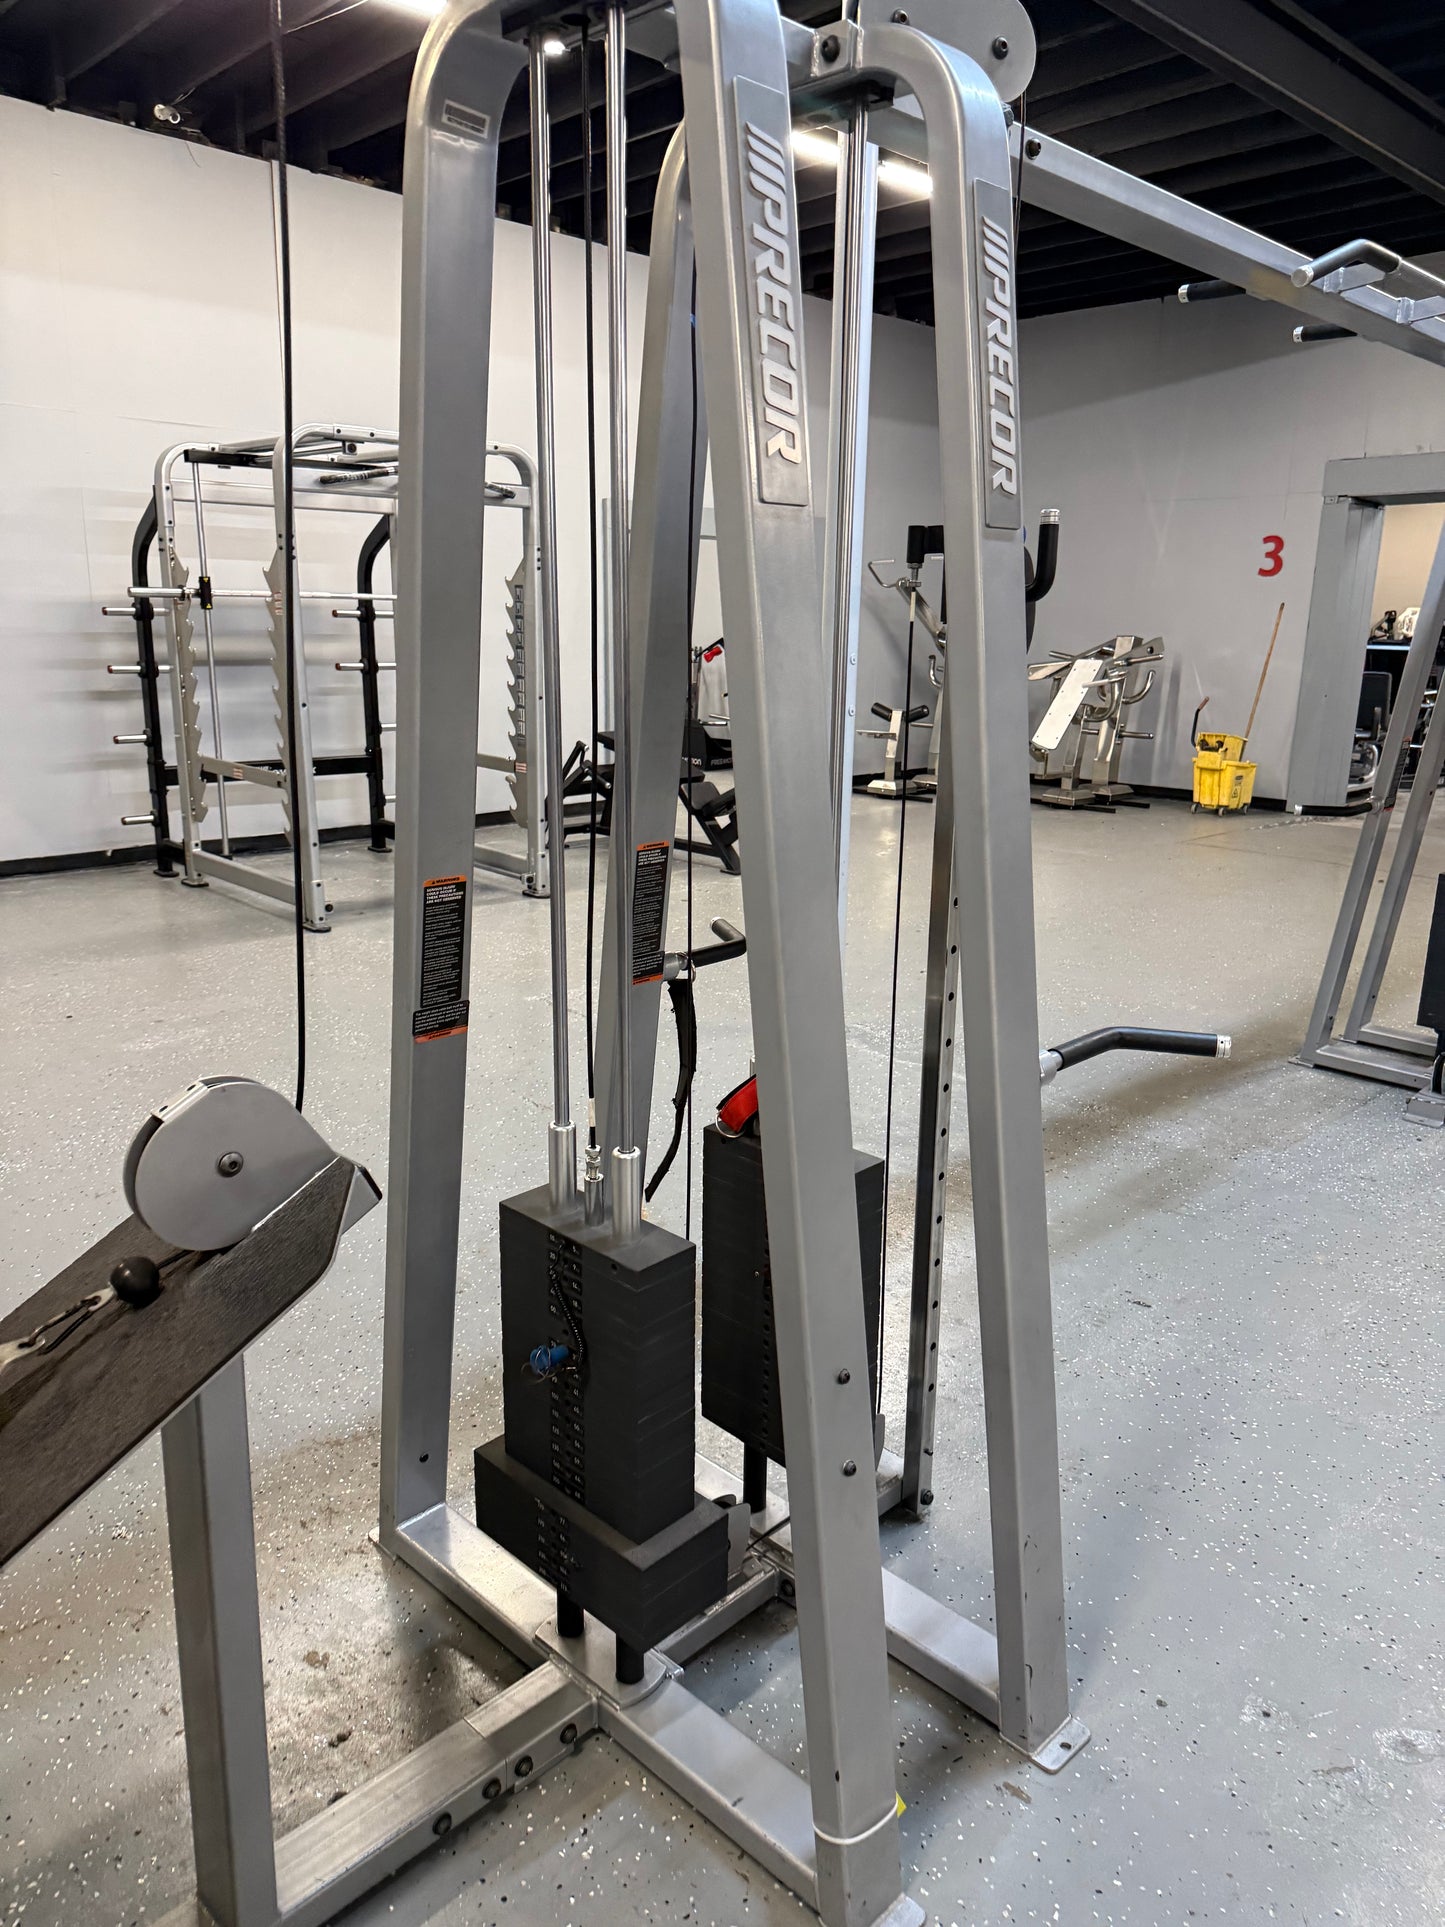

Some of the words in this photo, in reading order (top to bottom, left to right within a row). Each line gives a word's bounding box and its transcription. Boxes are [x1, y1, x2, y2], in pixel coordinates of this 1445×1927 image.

[747, 162, 802, 465] PRECOR
[982, 246, 1018, 496] PRECOR
[1257, 535, 1284, 578] 3
